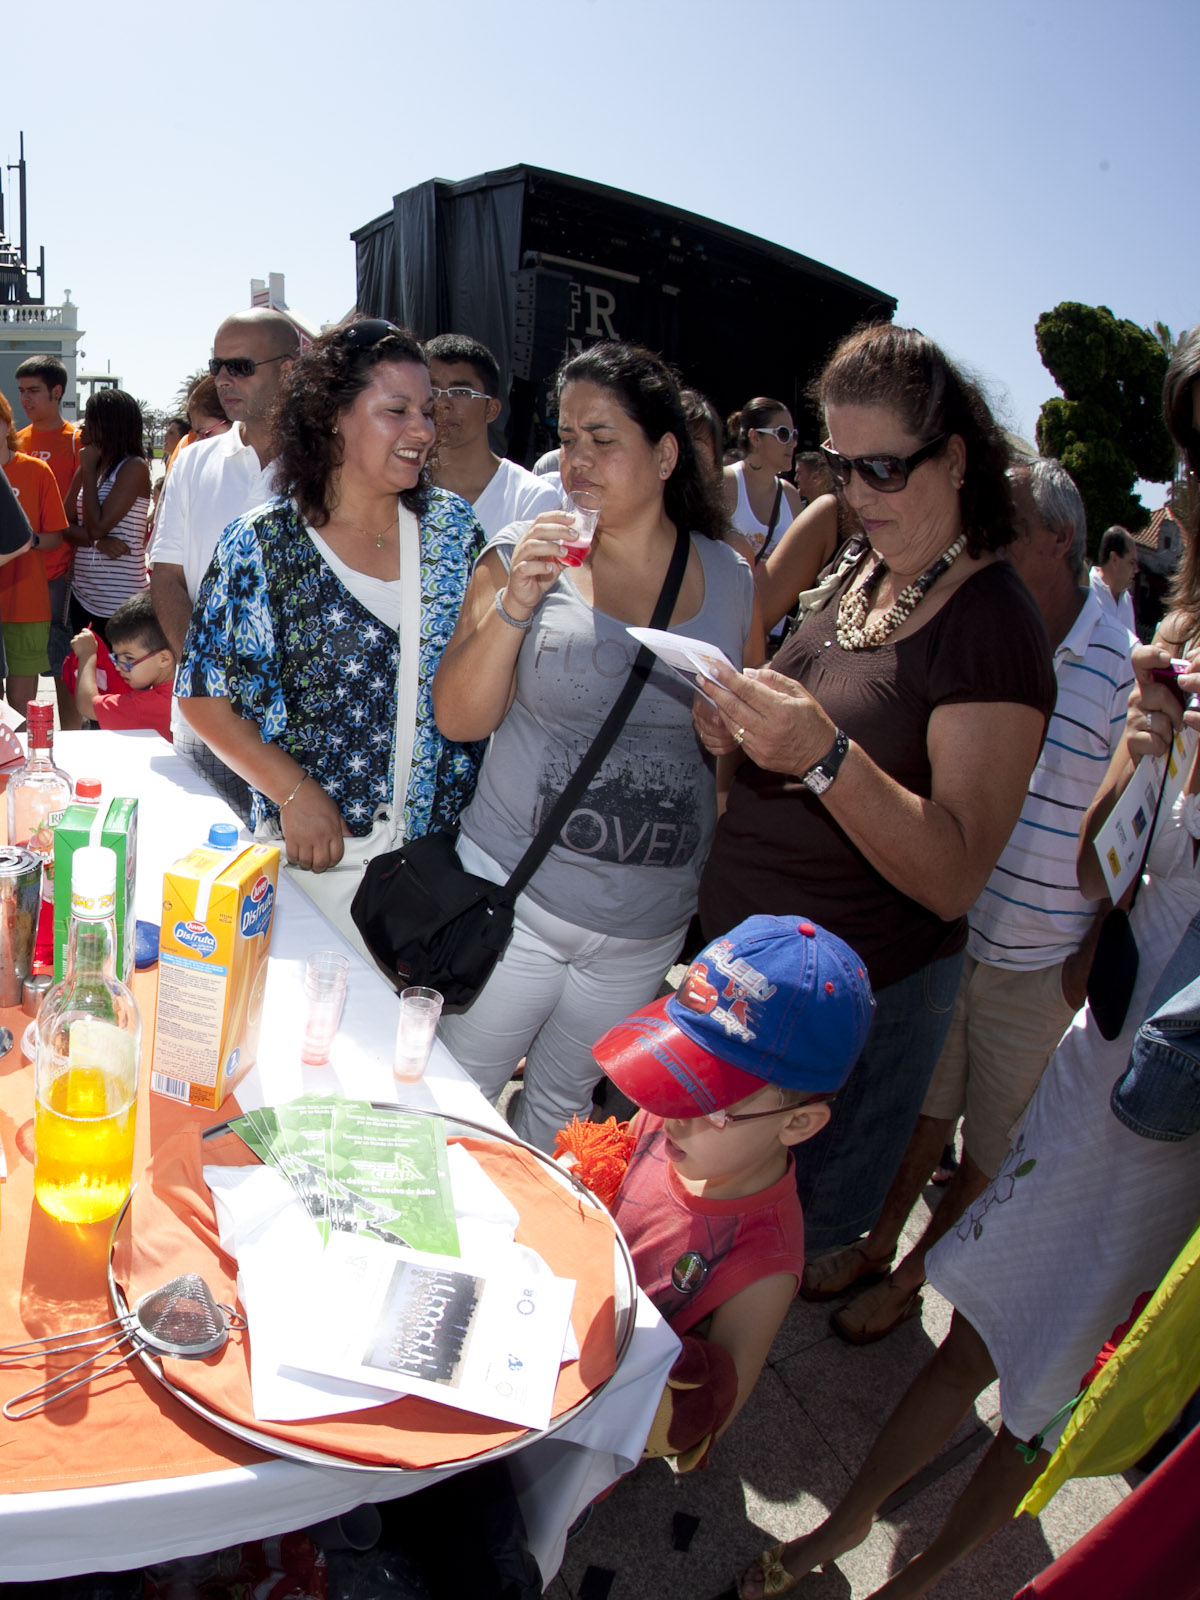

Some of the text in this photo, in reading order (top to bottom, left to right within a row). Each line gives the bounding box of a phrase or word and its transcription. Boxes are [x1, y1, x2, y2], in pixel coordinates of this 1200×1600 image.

[242, 891, 274, 932] Disfruta
[176, 928, 215, 946] Disfruta
[709, 1005, 758, 1044] DRIFT
[371, 1186, 405, 1195] Derecho
[416, 1187, 437, 1196] Asilo
